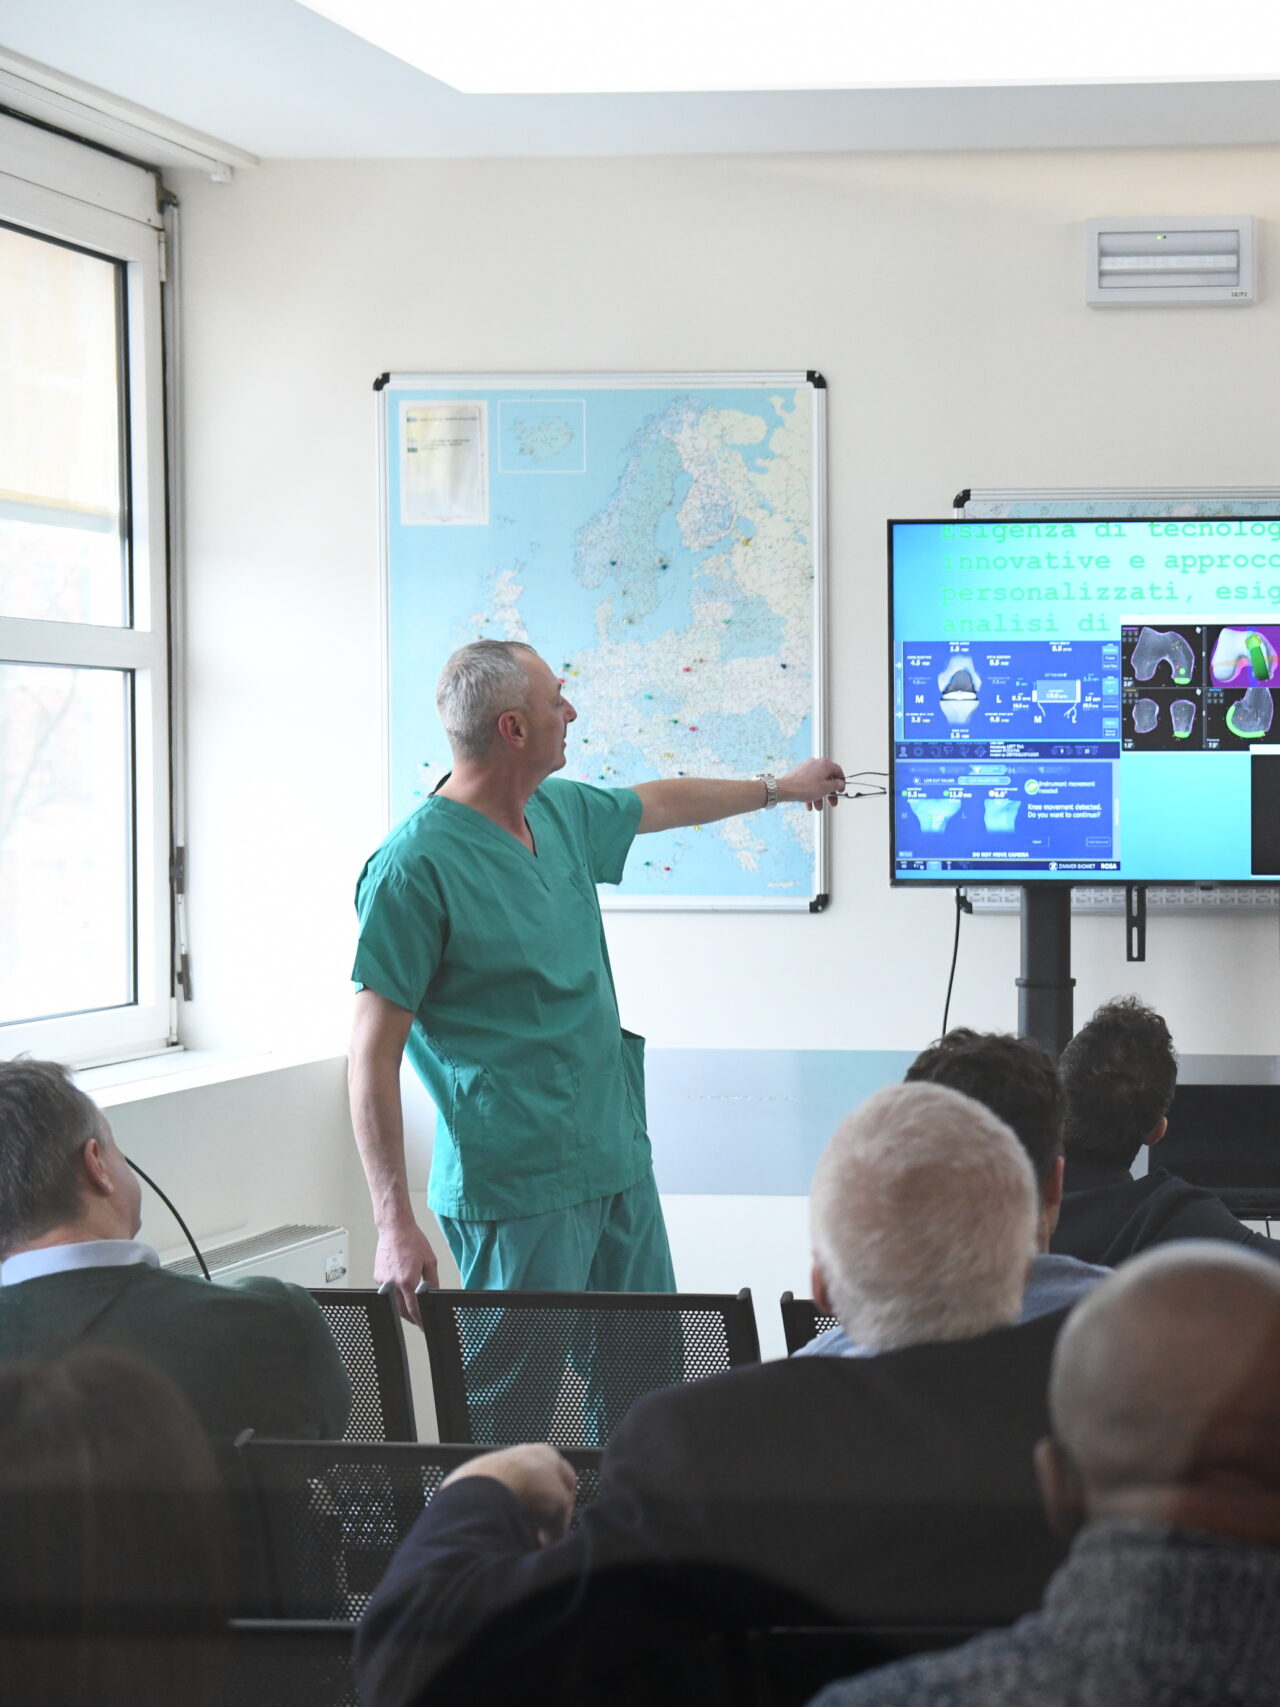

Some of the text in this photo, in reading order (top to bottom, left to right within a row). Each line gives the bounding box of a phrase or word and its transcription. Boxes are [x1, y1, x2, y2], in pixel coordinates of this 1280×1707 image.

[941, 522, 1077, 543] Esigenza
[1095, 522, 1127, 538] di
[943, 551, 1111, 570] innovative
[1129, 554, 1145, 569] e
[941, 581, 1193, 607] personalizzati,
[943, 613, 1110, 633] analisi di
[915, 695, 1002, 703] M L
[1037, 812, 1048, 820] you
